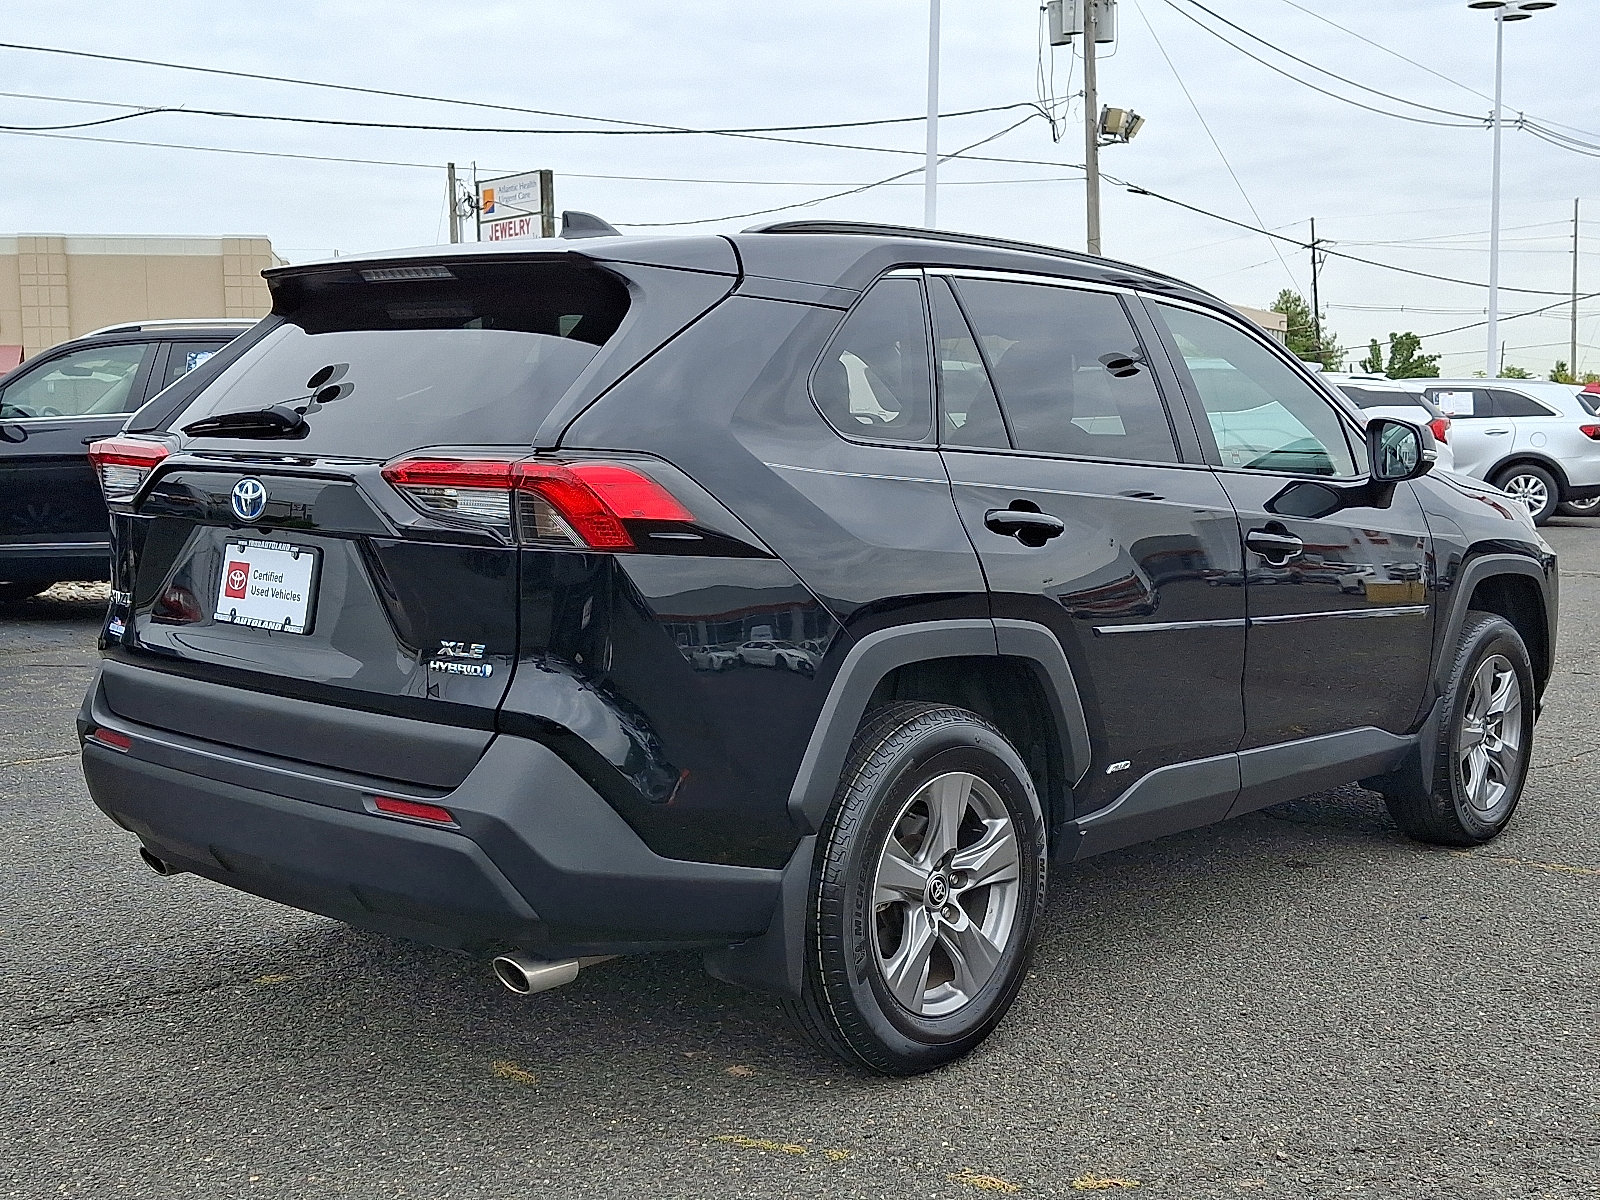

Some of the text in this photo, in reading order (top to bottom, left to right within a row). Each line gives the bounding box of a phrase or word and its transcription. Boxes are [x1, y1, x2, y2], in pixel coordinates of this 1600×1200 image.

[498, 180, 537, 192] Atlantic Health
[498, 191, 531, 203] Urgent Care
[489, 217, 531, 241] JEWELRY
[253, 569, 284, 583] Certified
[250, 585, 301, 602] Used Vehicles
[437, 640, 486, 659] XLE
[429, 660, 482, 677] HYBRID
